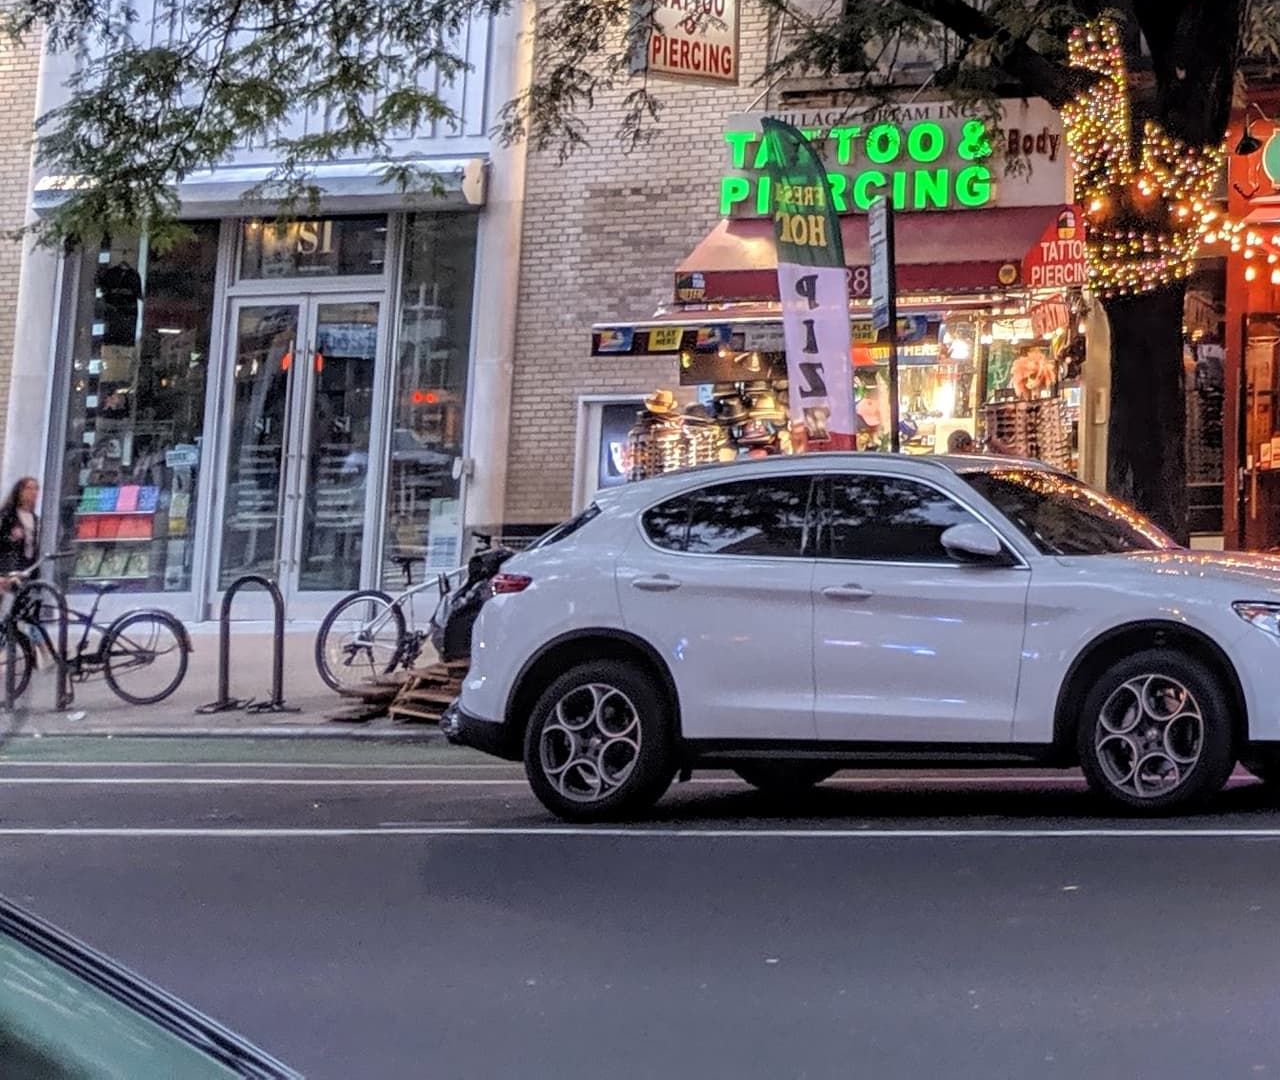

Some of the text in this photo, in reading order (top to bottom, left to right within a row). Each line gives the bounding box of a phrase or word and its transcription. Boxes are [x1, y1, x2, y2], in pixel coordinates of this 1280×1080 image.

[652, 34, 732, 75] PIERCING
[957, 119, 994, 161] &
[1007, 127, 1060, 162] Body
[1030, 262, 1088, 285] PIERCIN
